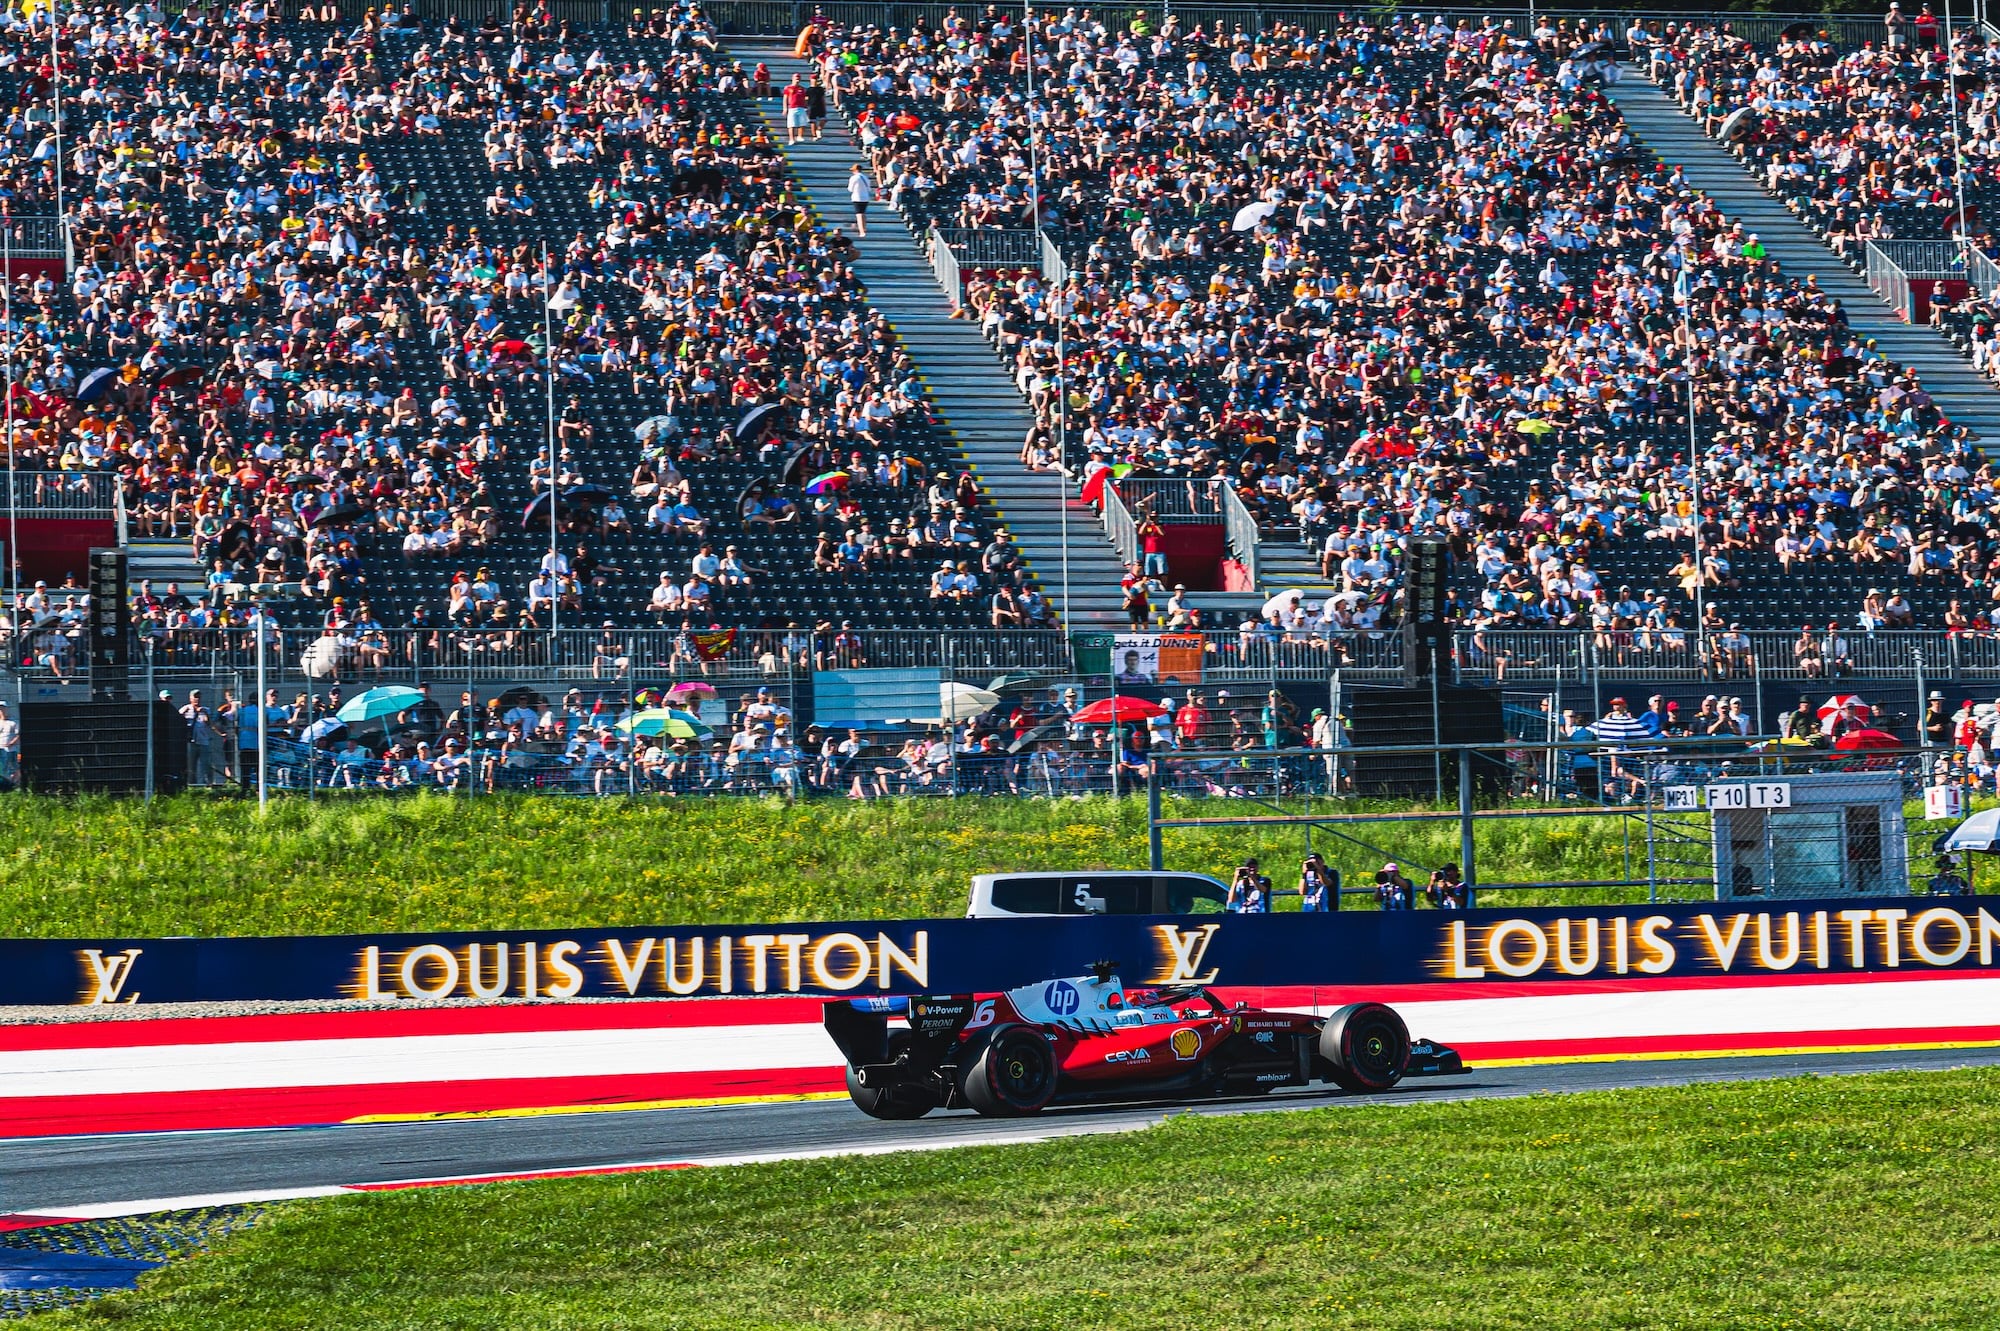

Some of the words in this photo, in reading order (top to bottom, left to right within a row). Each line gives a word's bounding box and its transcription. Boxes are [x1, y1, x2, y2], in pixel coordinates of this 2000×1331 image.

[1113, 639, 1138, 650] gets
[1140, 638, 1150, 648] it
[1152, 638, 1201, 649] DUNNE
[1709, 788, 1718, 806] F
[1724, 788, 1743, 806] 10
[1756, 786, 1768, 804] T
[1773, 786, 1784, 804] 3
[1074, 883, 1090, 907] 5
[1453, 916, 1676, 978] LOUIS
[366, 940, 584, 1000] LOUIS
[606, 930, 929, 996] VUITTON
[1050, 980, 1075, 1016] hp
[926, 1005, 963, 1015] V-Power
[1152, 1012, 1169, 1021] ZYN
[921, 1018, 954, 1029] PERONI
